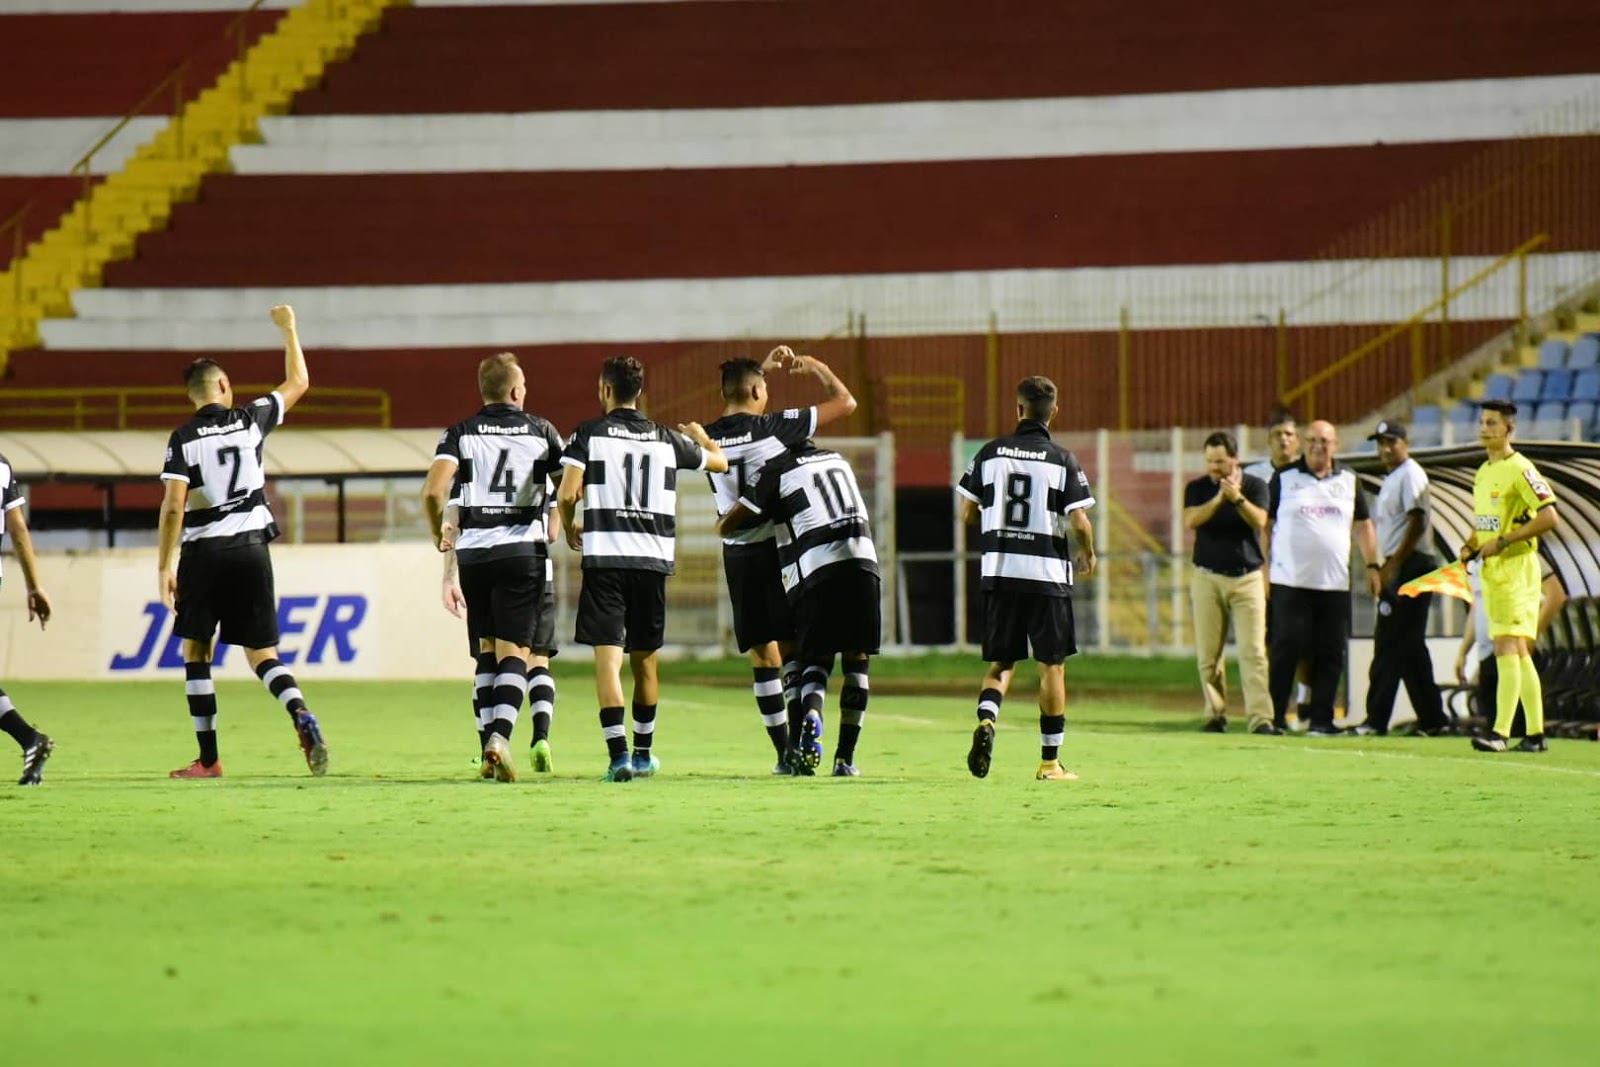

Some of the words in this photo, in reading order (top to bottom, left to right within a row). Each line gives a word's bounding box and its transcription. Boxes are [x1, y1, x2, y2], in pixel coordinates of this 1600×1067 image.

[478, 424, 529, 435] Unimed
[607, 426, 657, 440] Unimed
[711, 431, 753, 448] nimed
[997, 447, 1047, 460] Unimed
[217, 446, 249, 500] 2
[488, 448, 517, 503] 4
[623, 452, 651, 508] 11
[812, 467, 860, 520] 10
[1005, 472, 1032, 528] 8
[109, 595, 369, 670] JER
